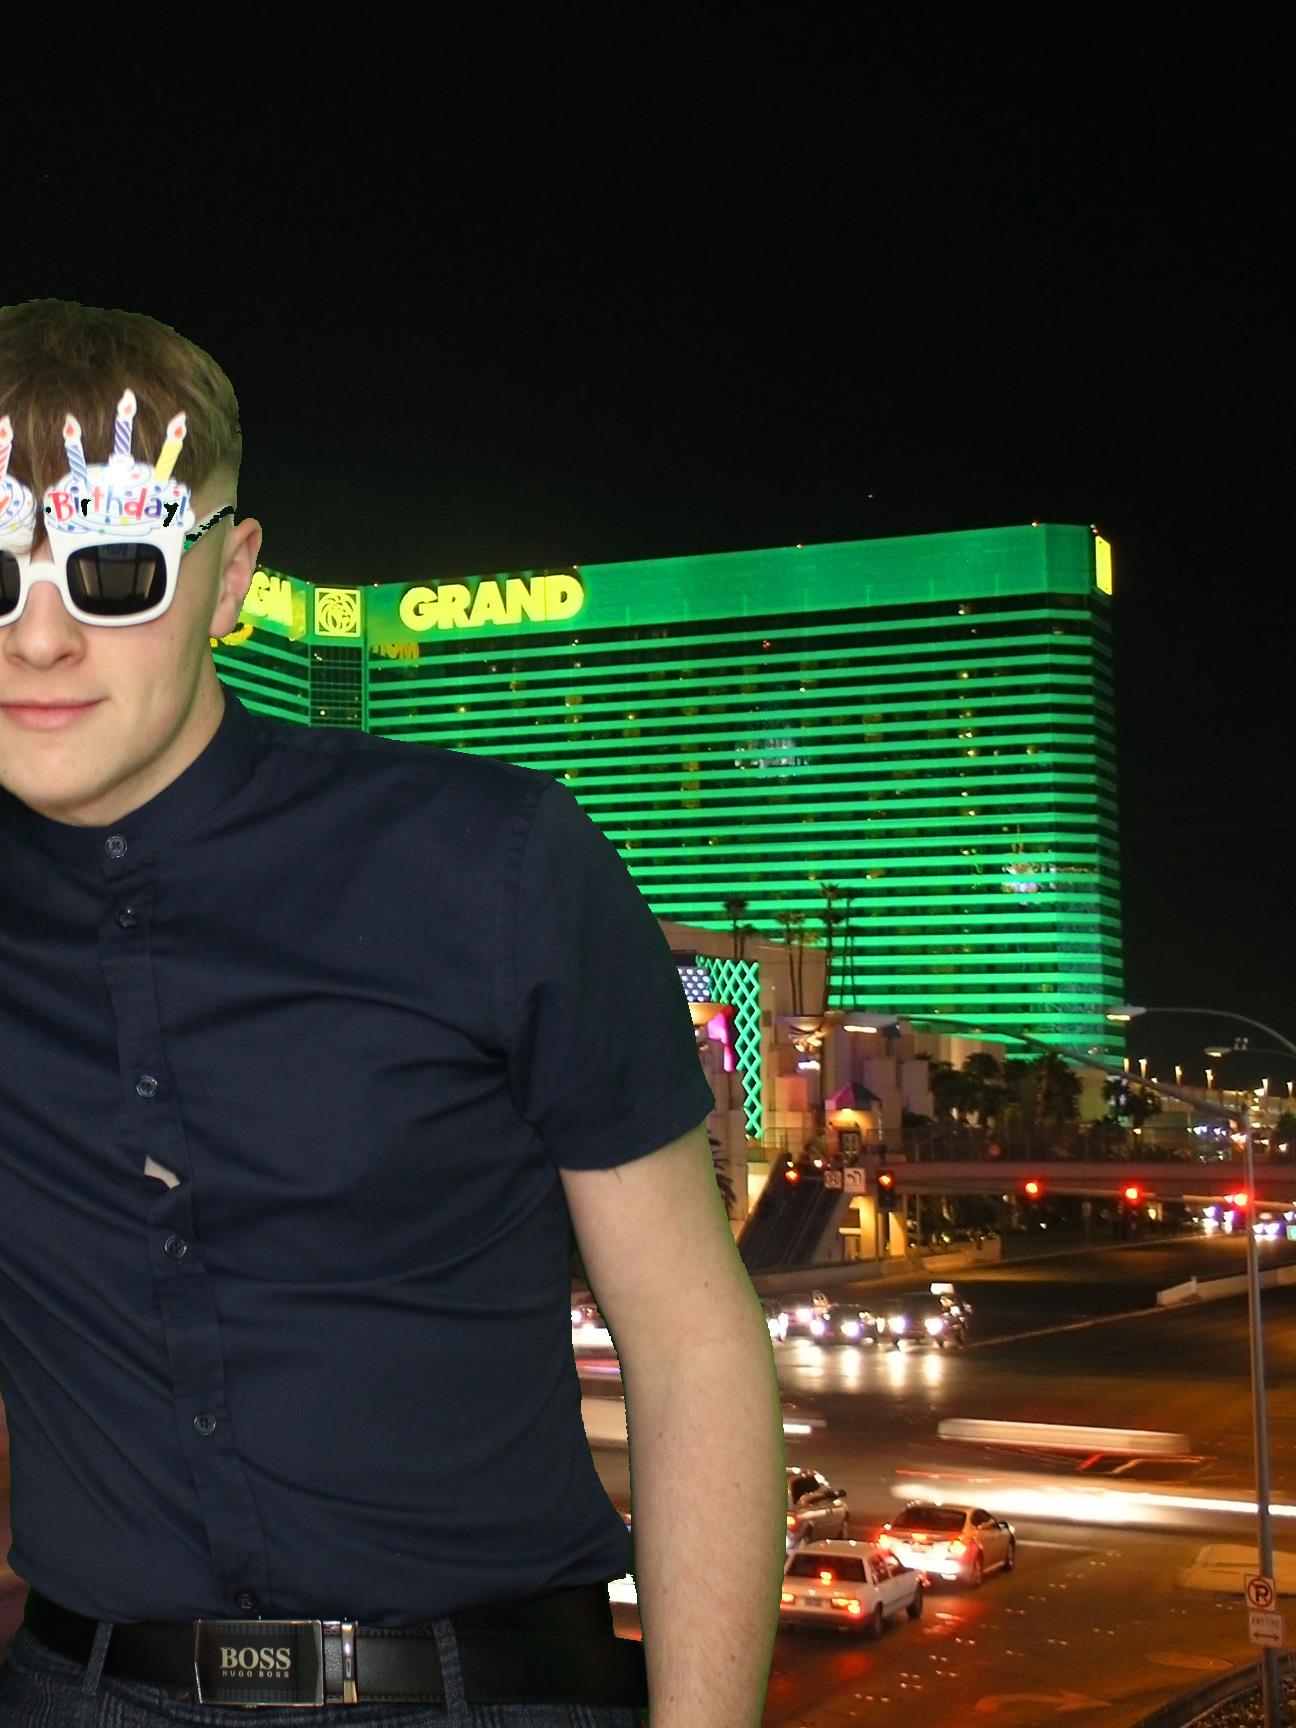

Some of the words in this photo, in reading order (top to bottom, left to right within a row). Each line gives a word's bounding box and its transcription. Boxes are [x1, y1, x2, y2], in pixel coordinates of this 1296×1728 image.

[47, 486, 188, 528] Birthday!
[243, 571, 294, 627] GM
[399, 574, 584, 632] GRAND
[220, 1647, 291, 1670] BOSS
